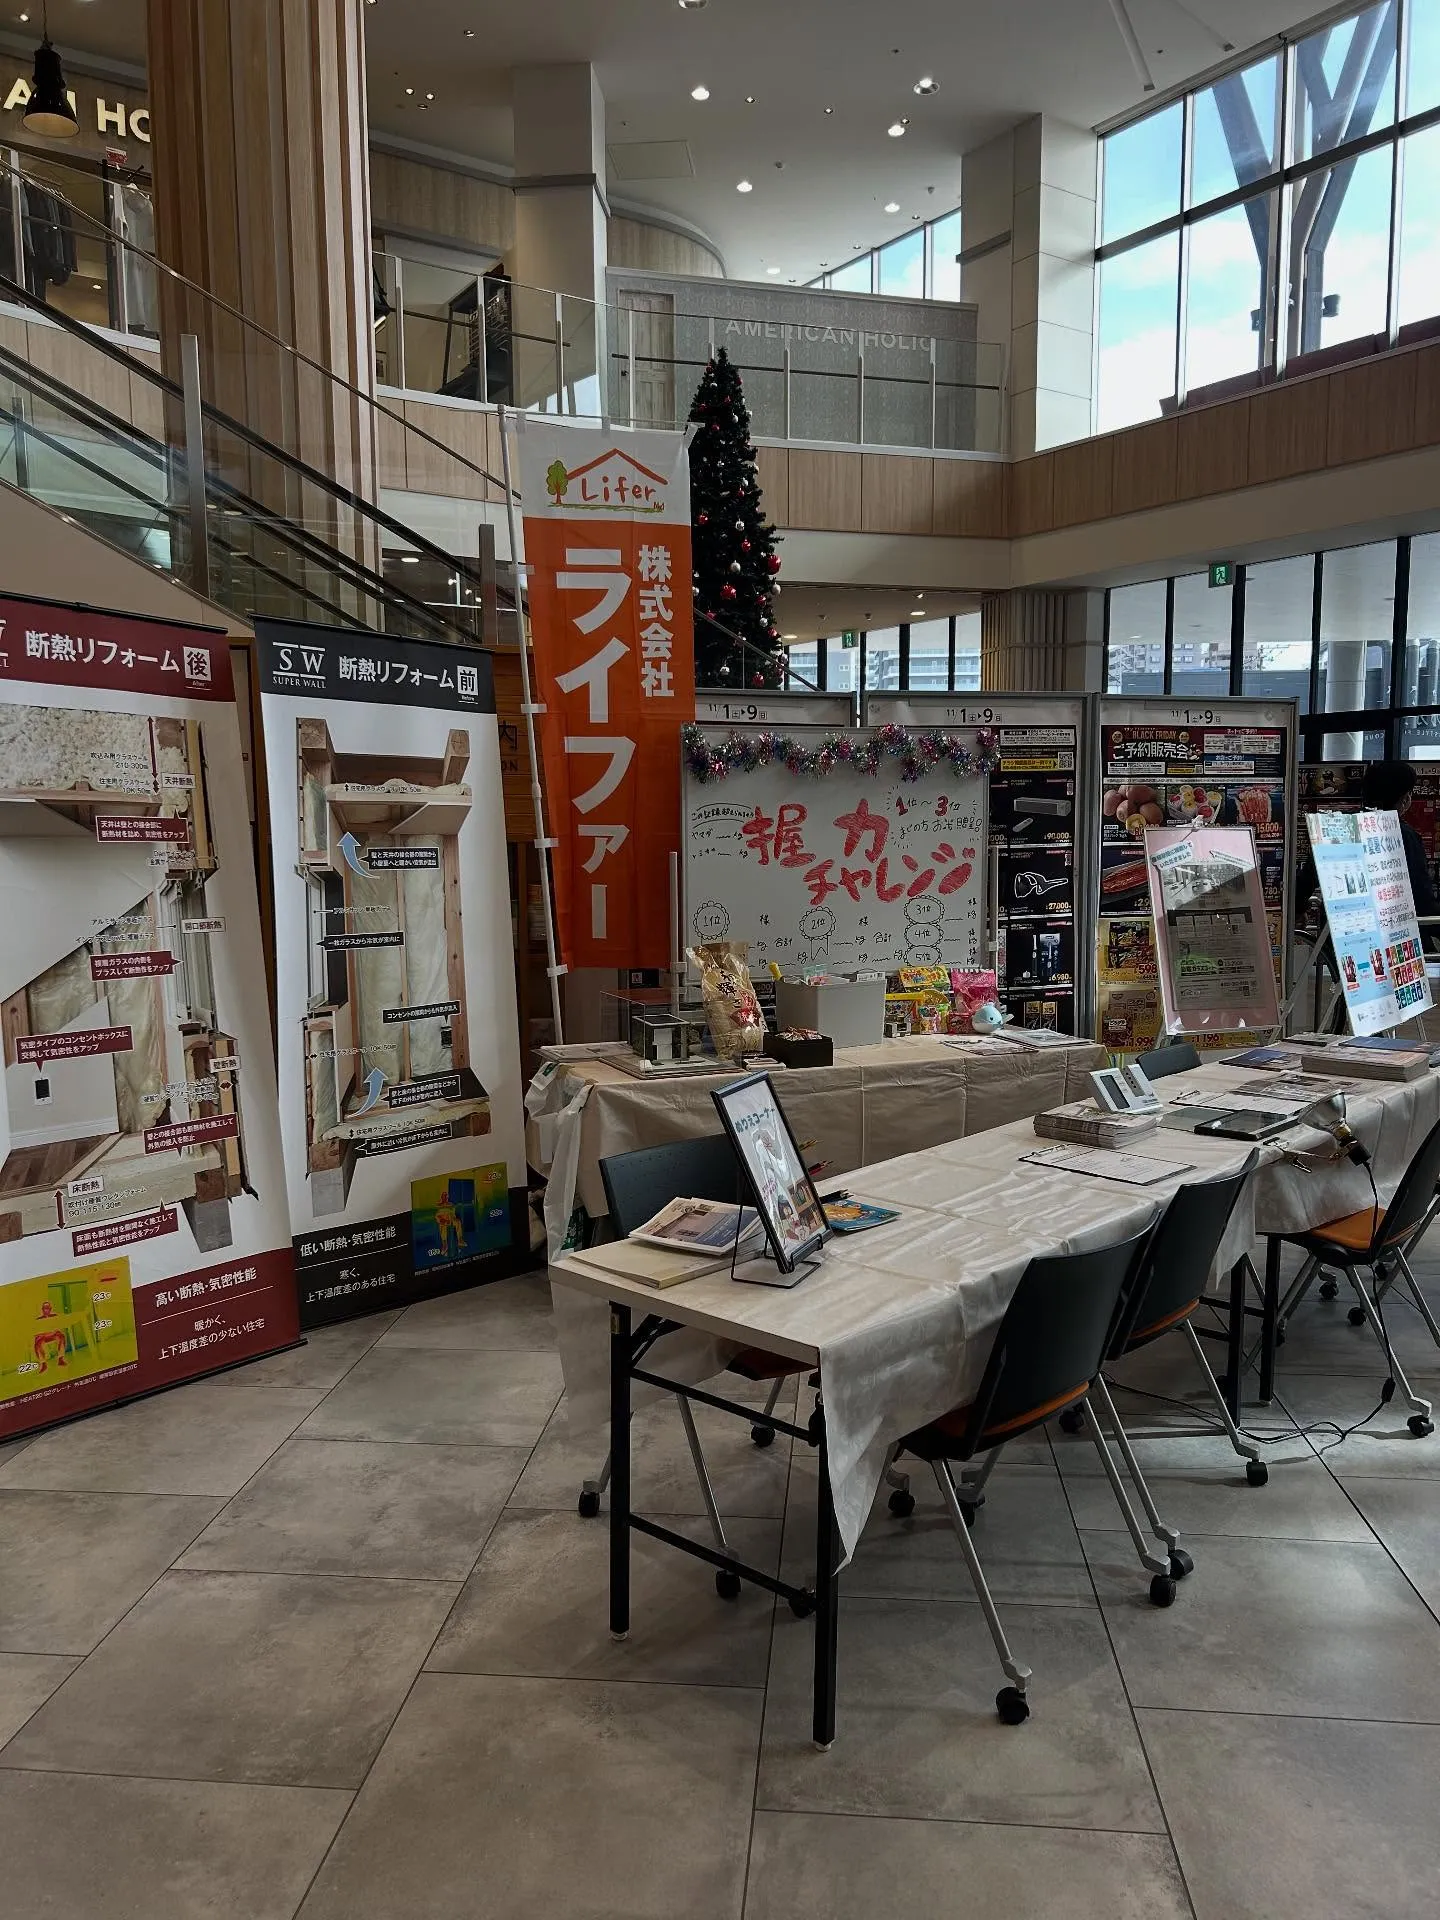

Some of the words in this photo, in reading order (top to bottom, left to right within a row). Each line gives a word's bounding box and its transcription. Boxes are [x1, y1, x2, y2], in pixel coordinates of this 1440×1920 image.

[724, 319, 854, 346] AMERICAN
[580, 475, 657, 503] Lifer
[637, 543, 674, 698] 株式会社
[24, 629, 181, 674] 断熱リフォーム
[187, 650, 208, 678] 後
[338, 655, 456, 690] 断熱リフォーム
[459, 669, 477, 693] 前
[272, 676, 301, 687] SUPER
[302, 678, 327, 690] WALL
[746, 704, 758, 720] 9
[982, 707, 993, 724] 9
[1204, 709, 1214, 724] 9
[554, 547, 637, 940] ライファー
[1132, 730, 1154, 740] BLACK
[1155, 730, 1177, 740] FRIDAY
[1112, 741, 1189, 760] ご予約販売会
[742, 797, 890, 866] 握力
[802, 841, 977, 906] チャレンジ
[916, 904, 931, 915] 3位
[703, 915, 721, 928] 1位
[811, 919, 826, 930] 2位
[774, 937, 792, 948] 合計
[873, 931, 892, 945] 合計
[914, 929, 931, 940] 4位
[915, 952, 932, 963] 5位
[1138, 963, 1158, 974] 598
[20, 1030, 129, 1050] 気密タイプのコンセントボックスに
[20, 1043, 100, 1060] 交換して気密性をアップ
[734, 1107, 776, 1134] ぬりえコーナー
[72, 1180, 100, 1195] 床断熱
[300, 1225, 397, 1258] 低い断熱・気密性能
[338, 1267, 361, 1281] 寒く、
[154, 1266, 258, 1308] 高い断熱・気密性能
[305, 1273, 396, 1304] 上下温度差のある住宅
[193, 1314, 226, 1332] 暖かく、
[158, 1317, 265, 1360] 上下温度差の少ない住宅
